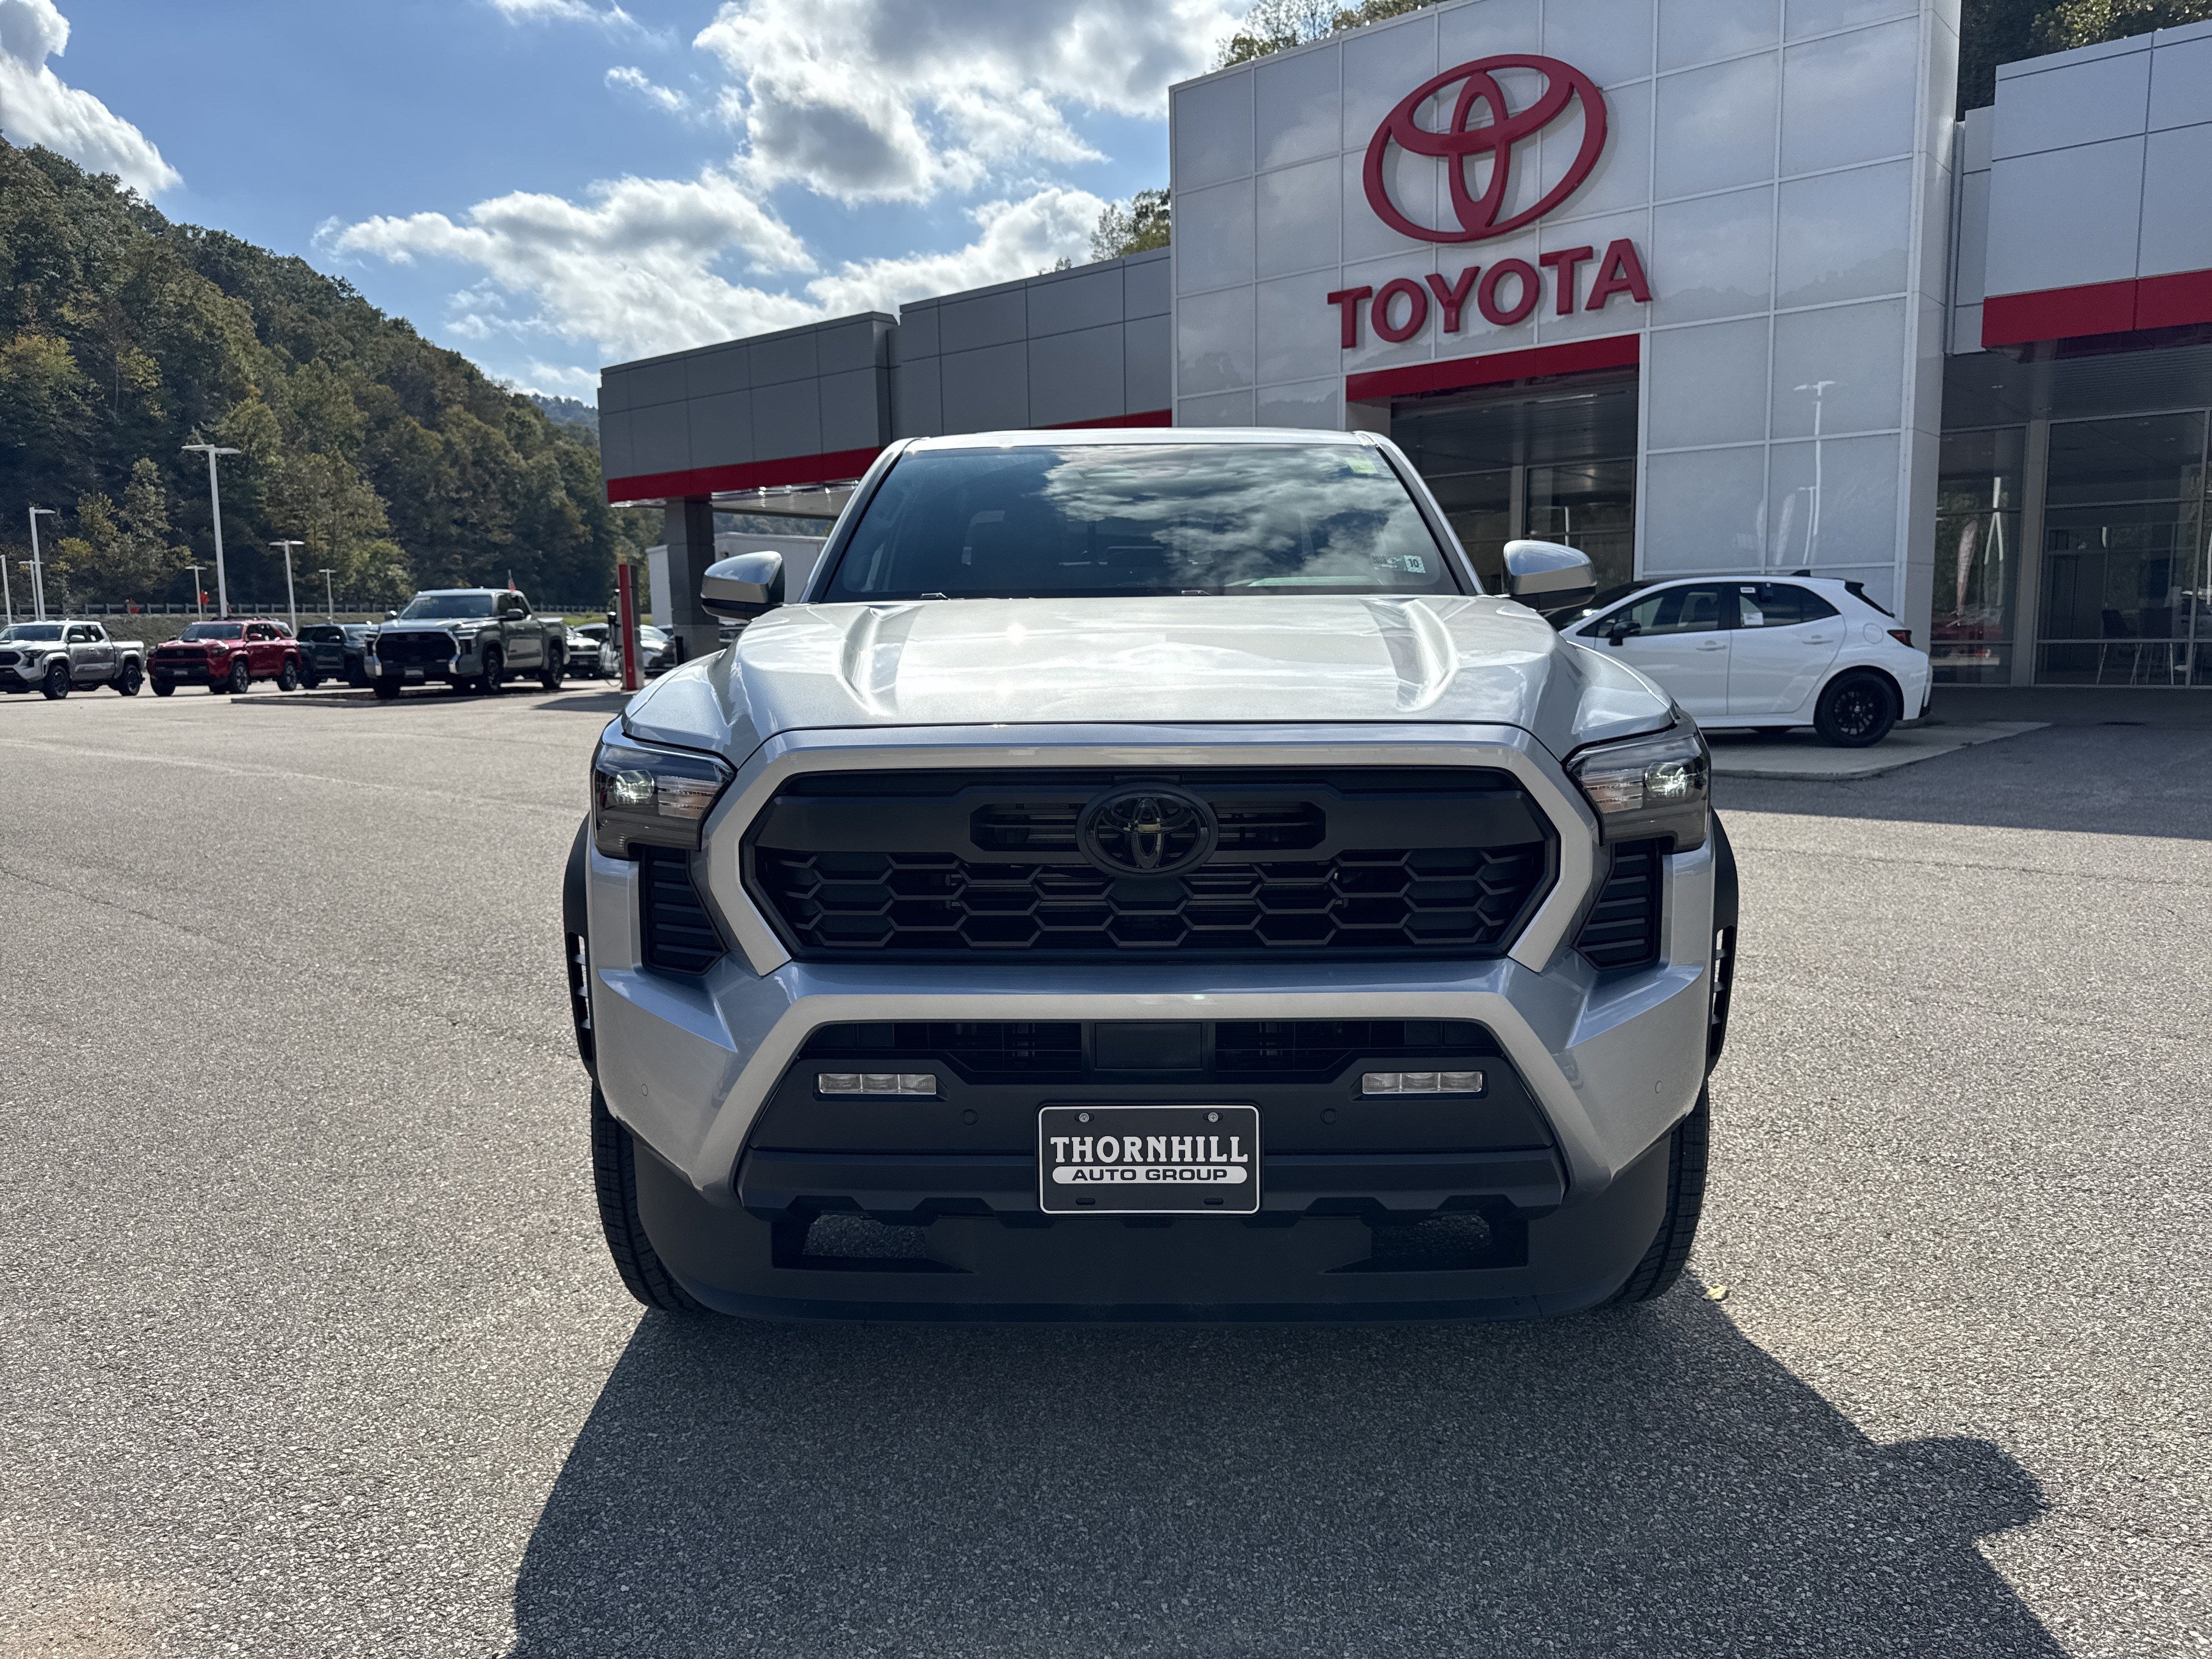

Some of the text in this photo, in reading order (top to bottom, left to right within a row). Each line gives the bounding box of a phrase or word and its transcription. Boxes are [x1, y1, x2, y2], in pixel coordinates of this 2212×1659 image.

[1327, 238, 1653, 349] TOYOTA
[1408, 558, 1419, 568] 10
[1050, 1136, 1248, 1163] THORNHILL
[1071, 1169, 1227, 1181] AUTO GROUP
